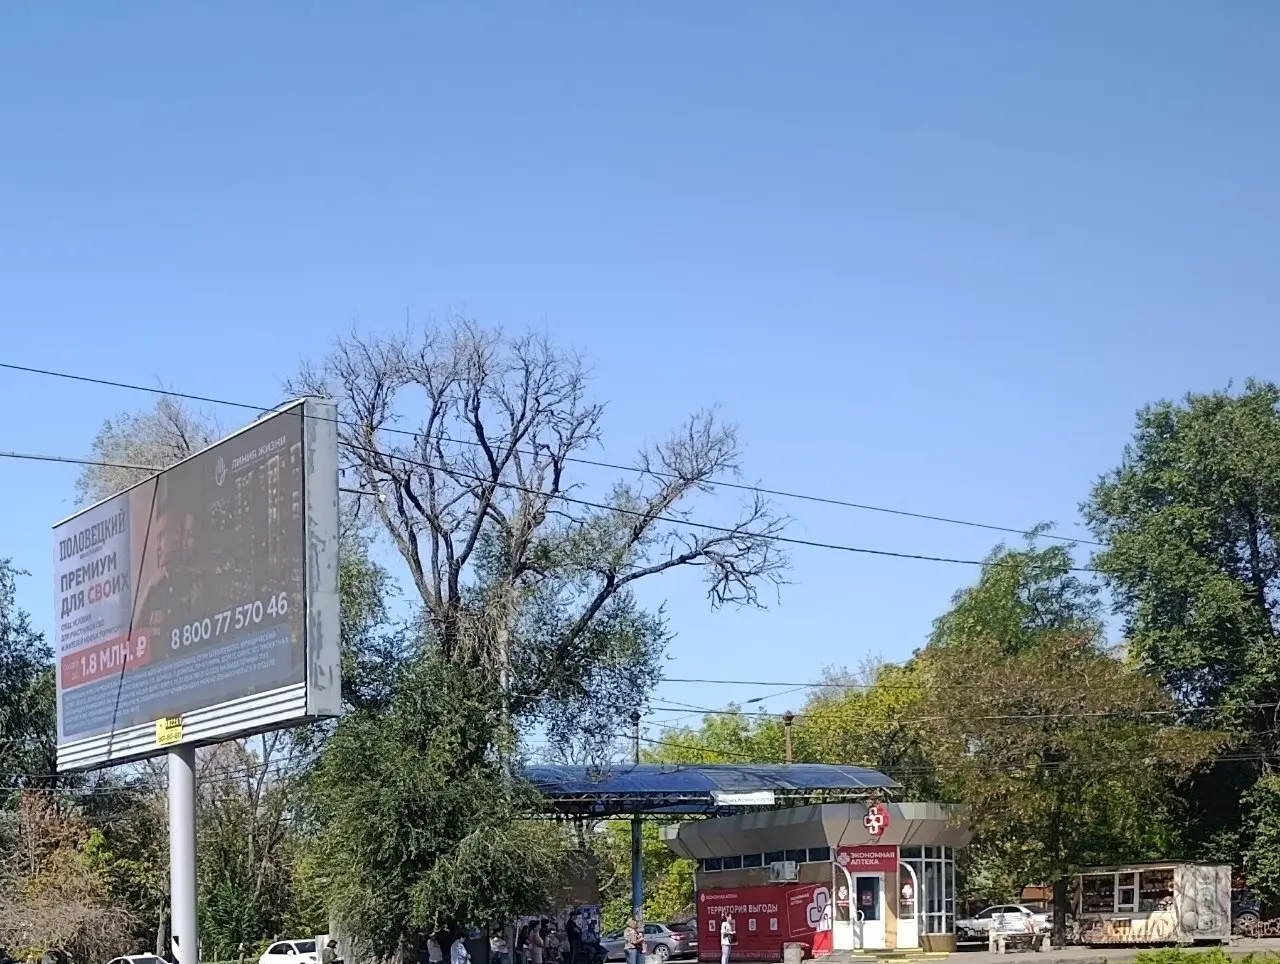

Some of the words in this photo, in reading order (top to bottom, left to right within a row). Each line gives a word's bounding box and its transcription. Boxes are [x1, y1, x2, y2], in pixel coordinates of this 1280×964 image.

[231, 449, 257, 470] ЛИНИЯ
[258, 435, 286, 456] ЖИЗНИ
[59, 508, 126, 562] ПОЛОВЕЦКИЙ
[60, 551, 117, 593] ПРЕМИУМ
[60, 590, 85, 620] ДЛЯ
[87, 571, 130, 605] СВОИХ
[171, 628, 180, 650] 8
[183, 617, 212, 646] 800
[214, 610, 232, 636] 77
[234, 600, 264, 629] 570
[266, 591, 288, 618] 46
[81, 651, 97, 677] 1.8
[100, 640, 133, 671] МЛН.
[136, 635, 147, 658] ₽
[707, 904, 748, 915] ТЕРРИТОРИЯ
[748, 903, 778, 914] ВЫГОДЫ
